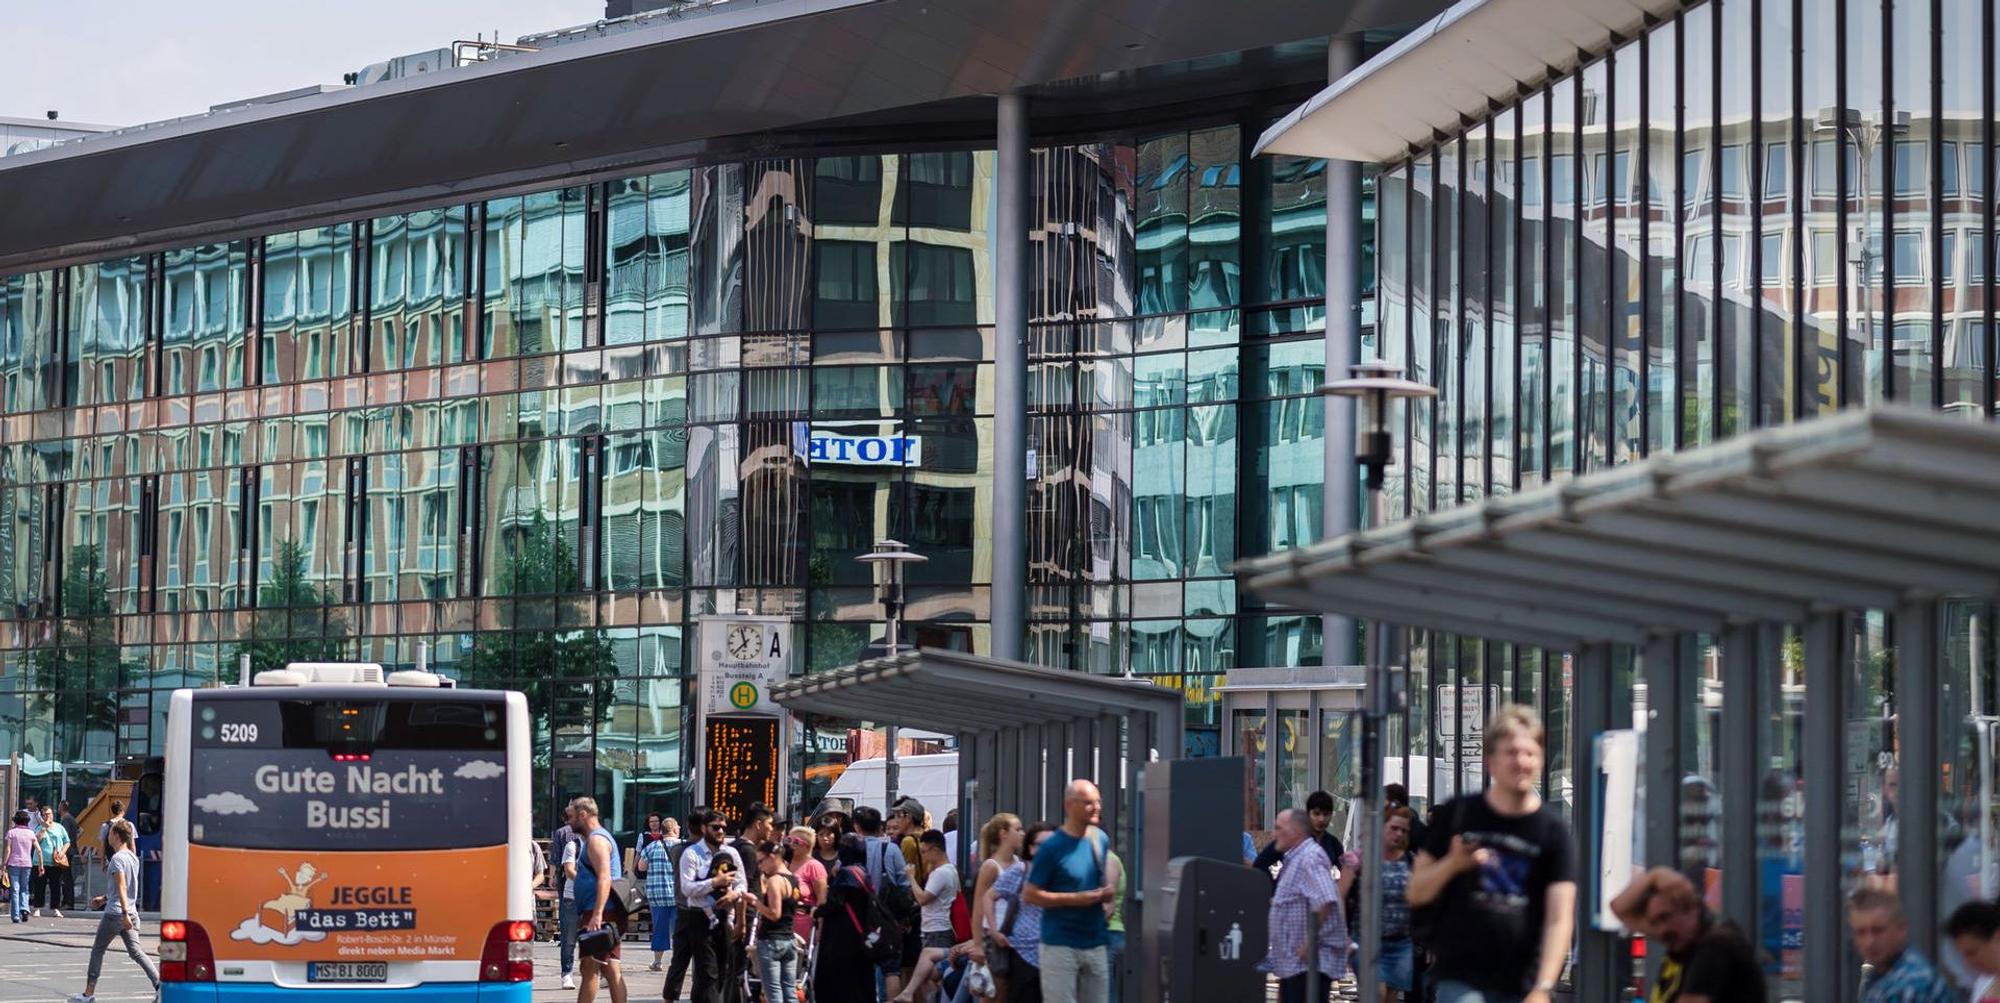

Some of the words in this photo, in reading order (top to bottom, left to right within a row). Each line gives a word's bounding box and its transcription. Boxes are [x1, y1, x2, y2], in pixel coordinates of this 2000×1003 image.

[769, 631, 781, 658] A
[718, 662, 770, 670] Hauptbahnhof
[725, 672, 757, 680] Bussteig
[738, 687, 750, 703] H
[220, 723, 258, 742] 5209
[255, 765, 335, 794] Gute
[348, 765, 443, 794] Nacht
[307, 800, 391, 829] Bussi
[330, 886, 412, 905] JEGGLE
[298, 911, 352, 928] "das
[355, 910, 413, 928] Bett"
[406, 935, 412, 943] 2
[414, 935, 422, 943] in
[424, 934, 457, 944] Münster
[338, 946, 365, 955] direkt
[367, 946, 396, 955] neben
[397, 946, 426, 955] Media
[427, 946, 456, 955] Markt
[316, 965, 331, 977] MS
[339, 965, 353, 977] BI
[356, 965, 385, 977] 8000
